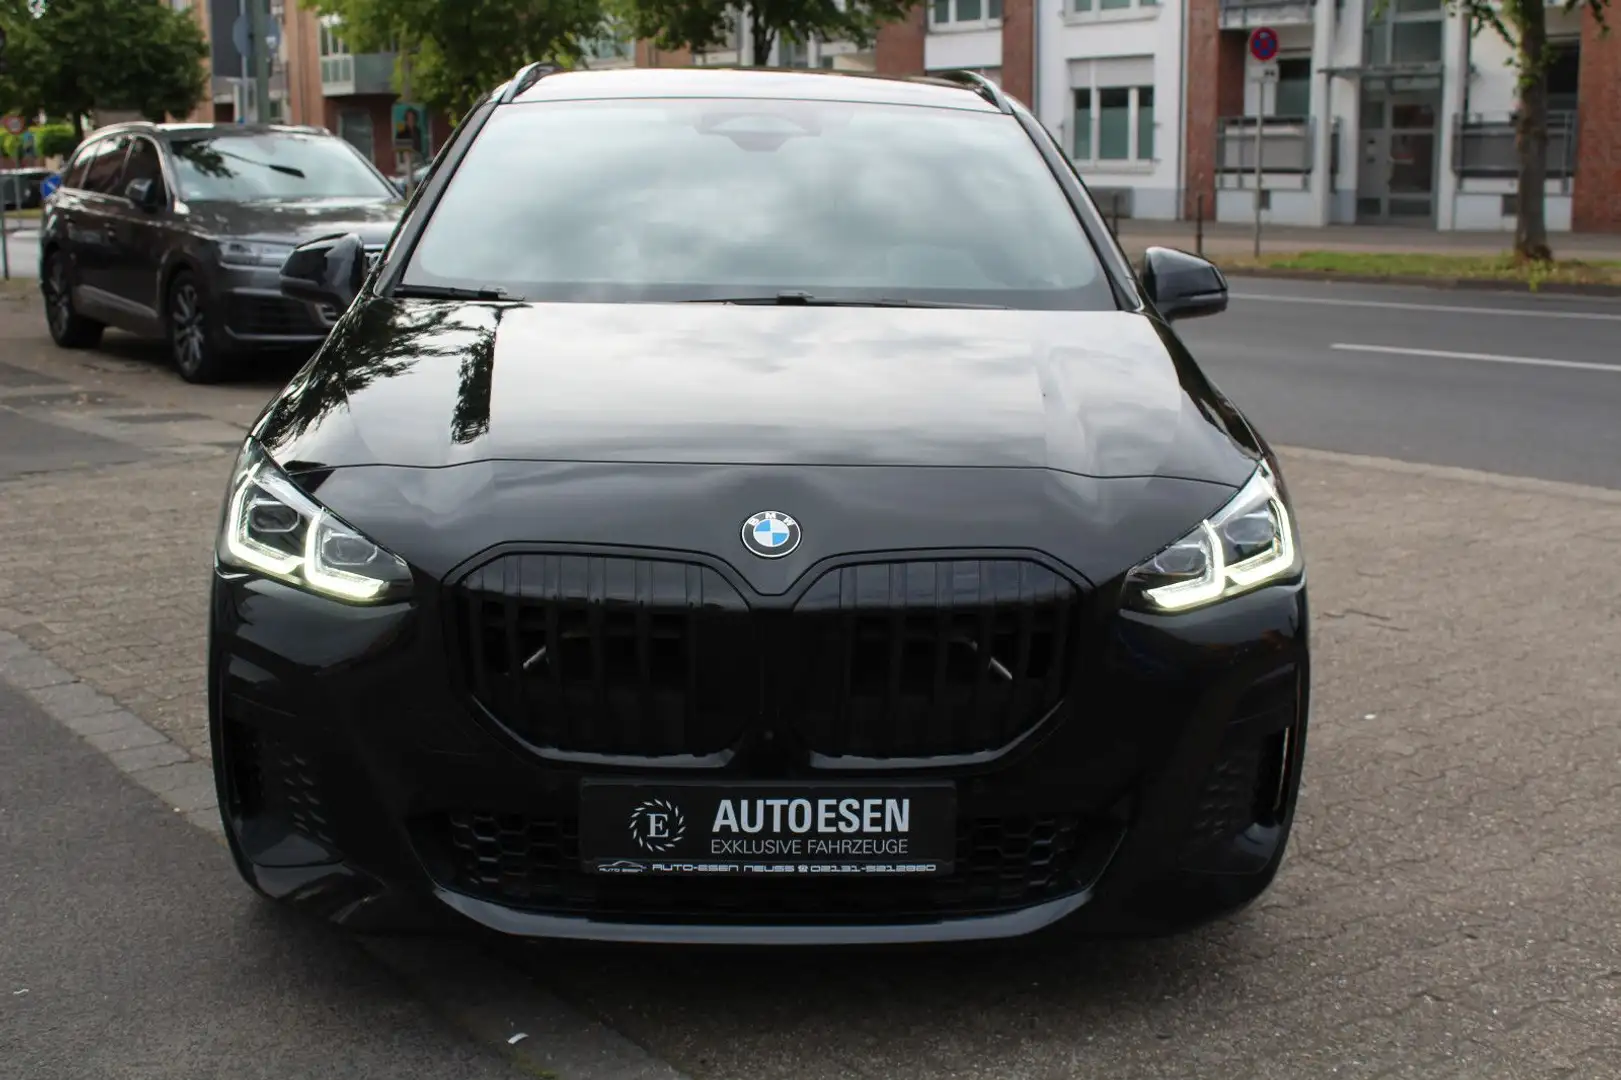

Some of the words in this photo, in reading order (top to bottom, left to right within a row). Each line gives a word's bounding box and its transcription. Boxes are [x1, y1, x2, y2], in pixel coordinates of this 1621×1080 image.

[747, 512, 796, 526] BMW
[647, 813, 669, 838] E
[711, 839, 802, 854] EXKLUSIVE
[807, 838, 909, 854] FAHRZEUGE
